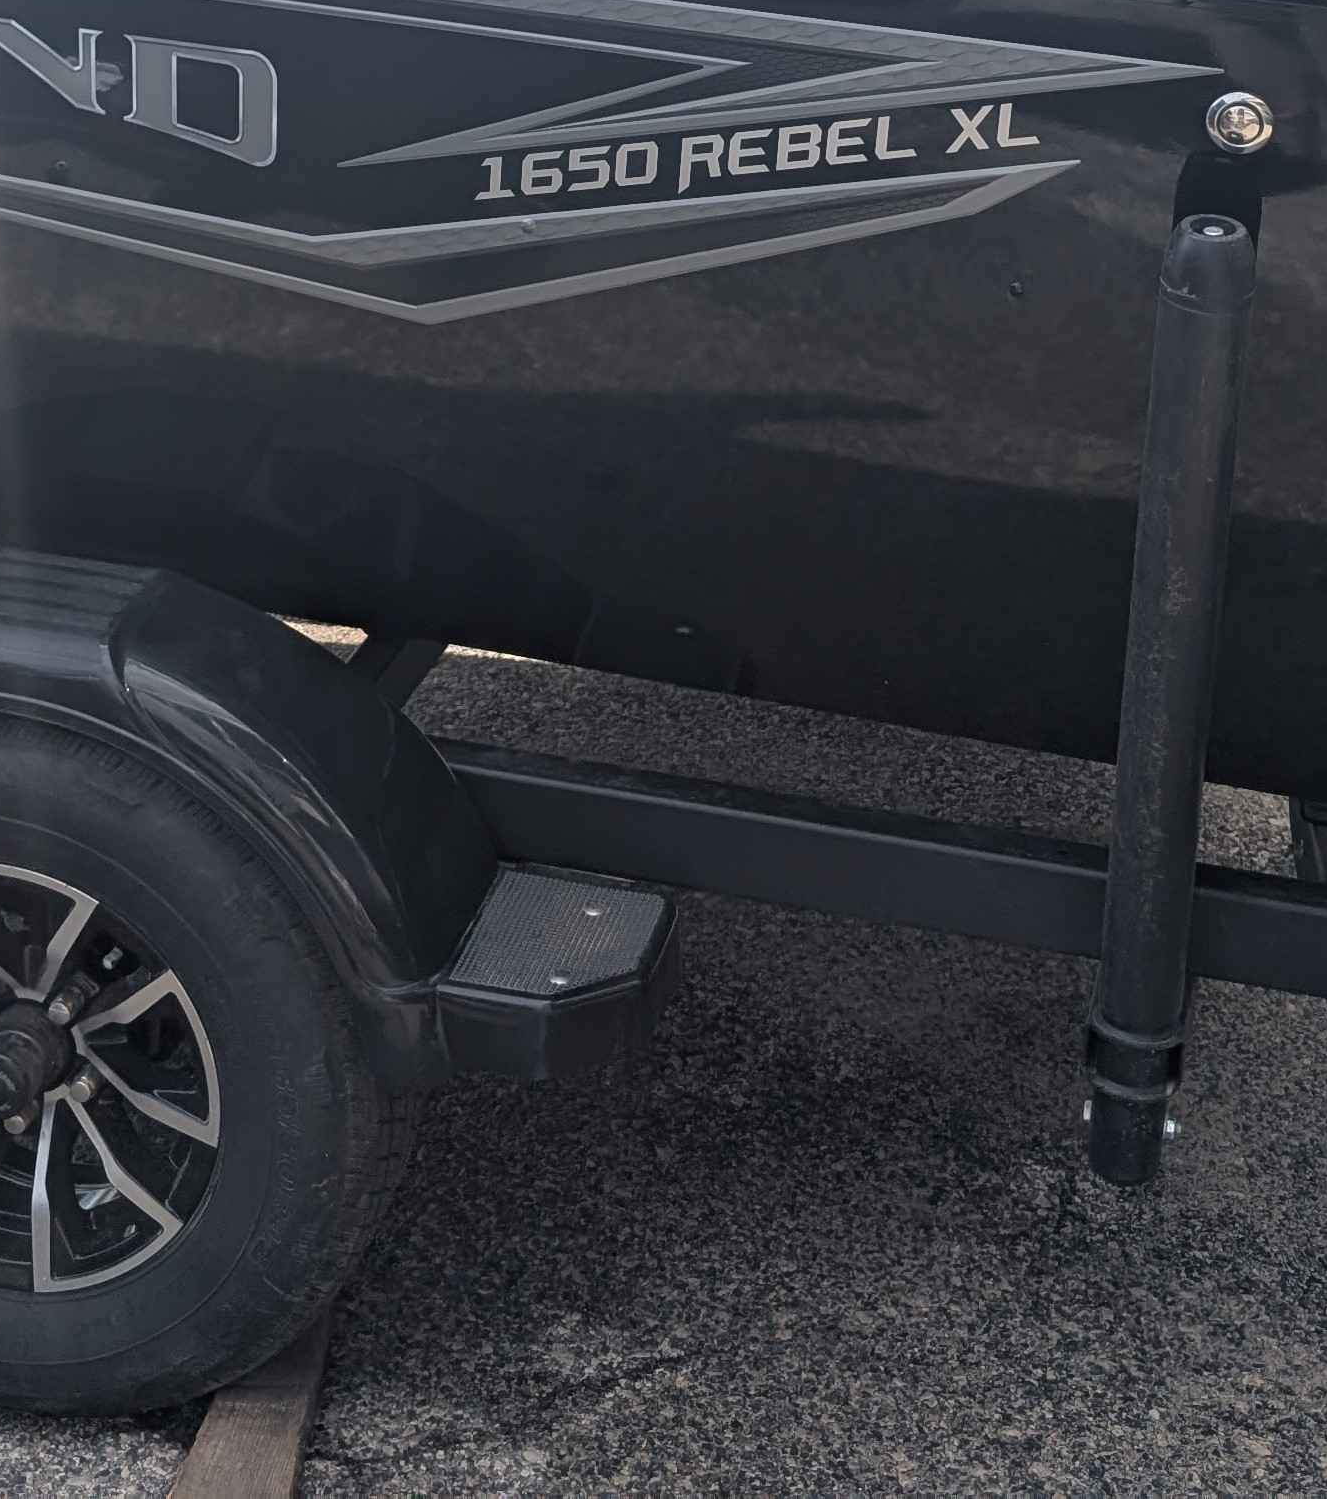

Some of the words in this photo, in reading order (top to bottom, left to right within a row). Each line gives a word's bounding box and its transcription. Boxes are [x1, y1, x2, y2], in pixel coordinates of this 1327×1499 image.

[474, 140, 659, 201] 1650
[677, 115, 917, 195] REBEL
[945, 102, 1041, 155] XL
